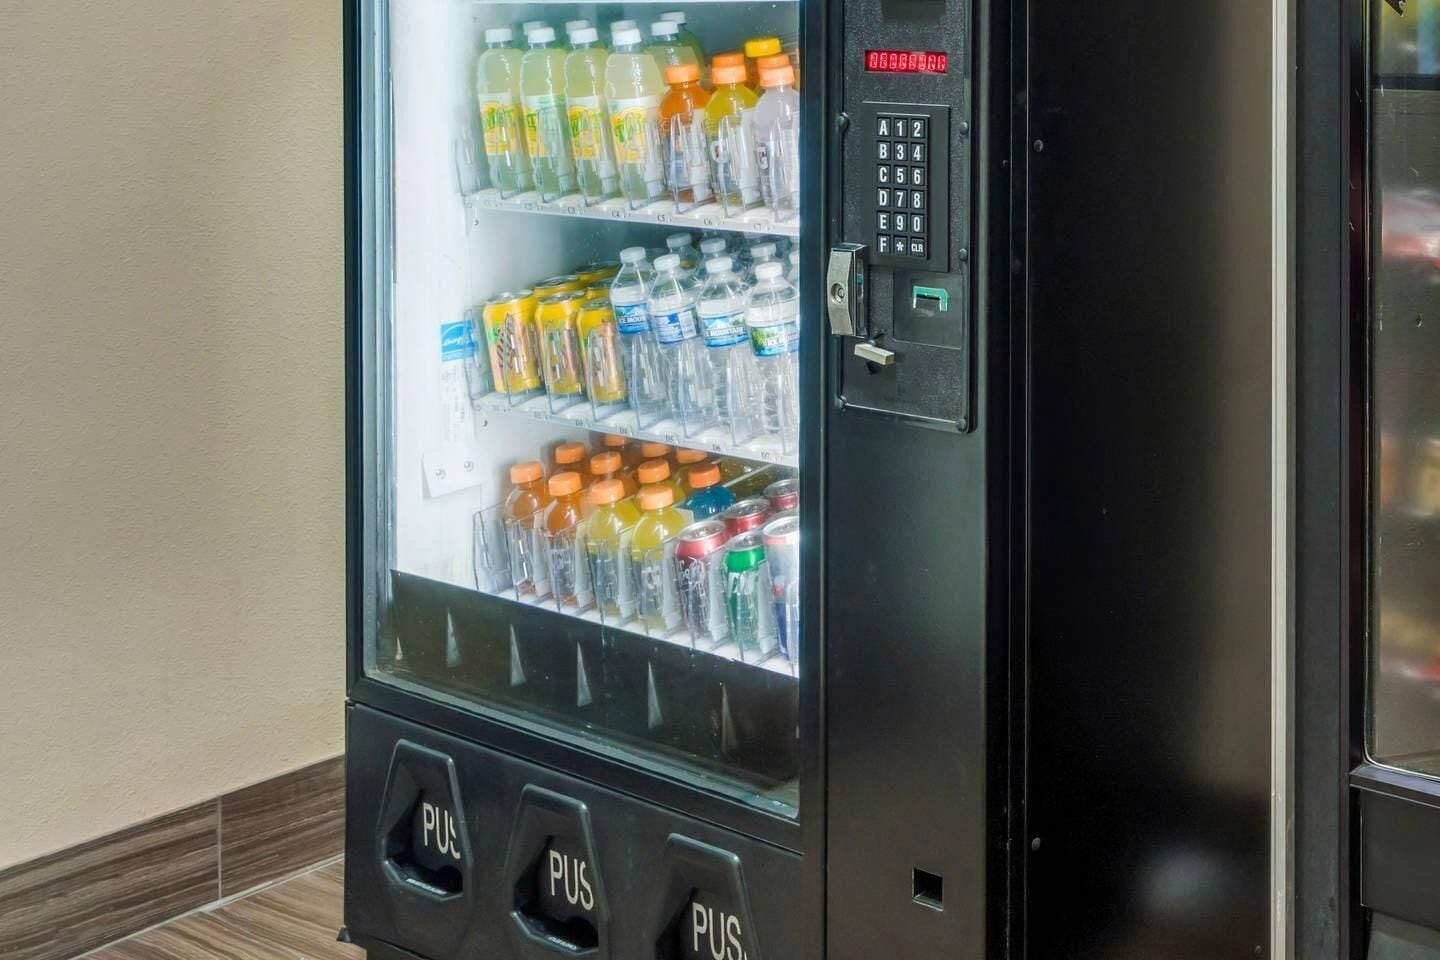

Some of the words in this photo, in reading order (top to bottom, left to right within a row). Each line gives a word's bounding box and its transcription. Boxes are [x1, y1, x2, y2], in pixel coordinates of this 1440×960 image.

[422, 802, 462, 860] PUS
[549, 850, 595, 911] PUS
[692, 902, 748, 960] PUS
